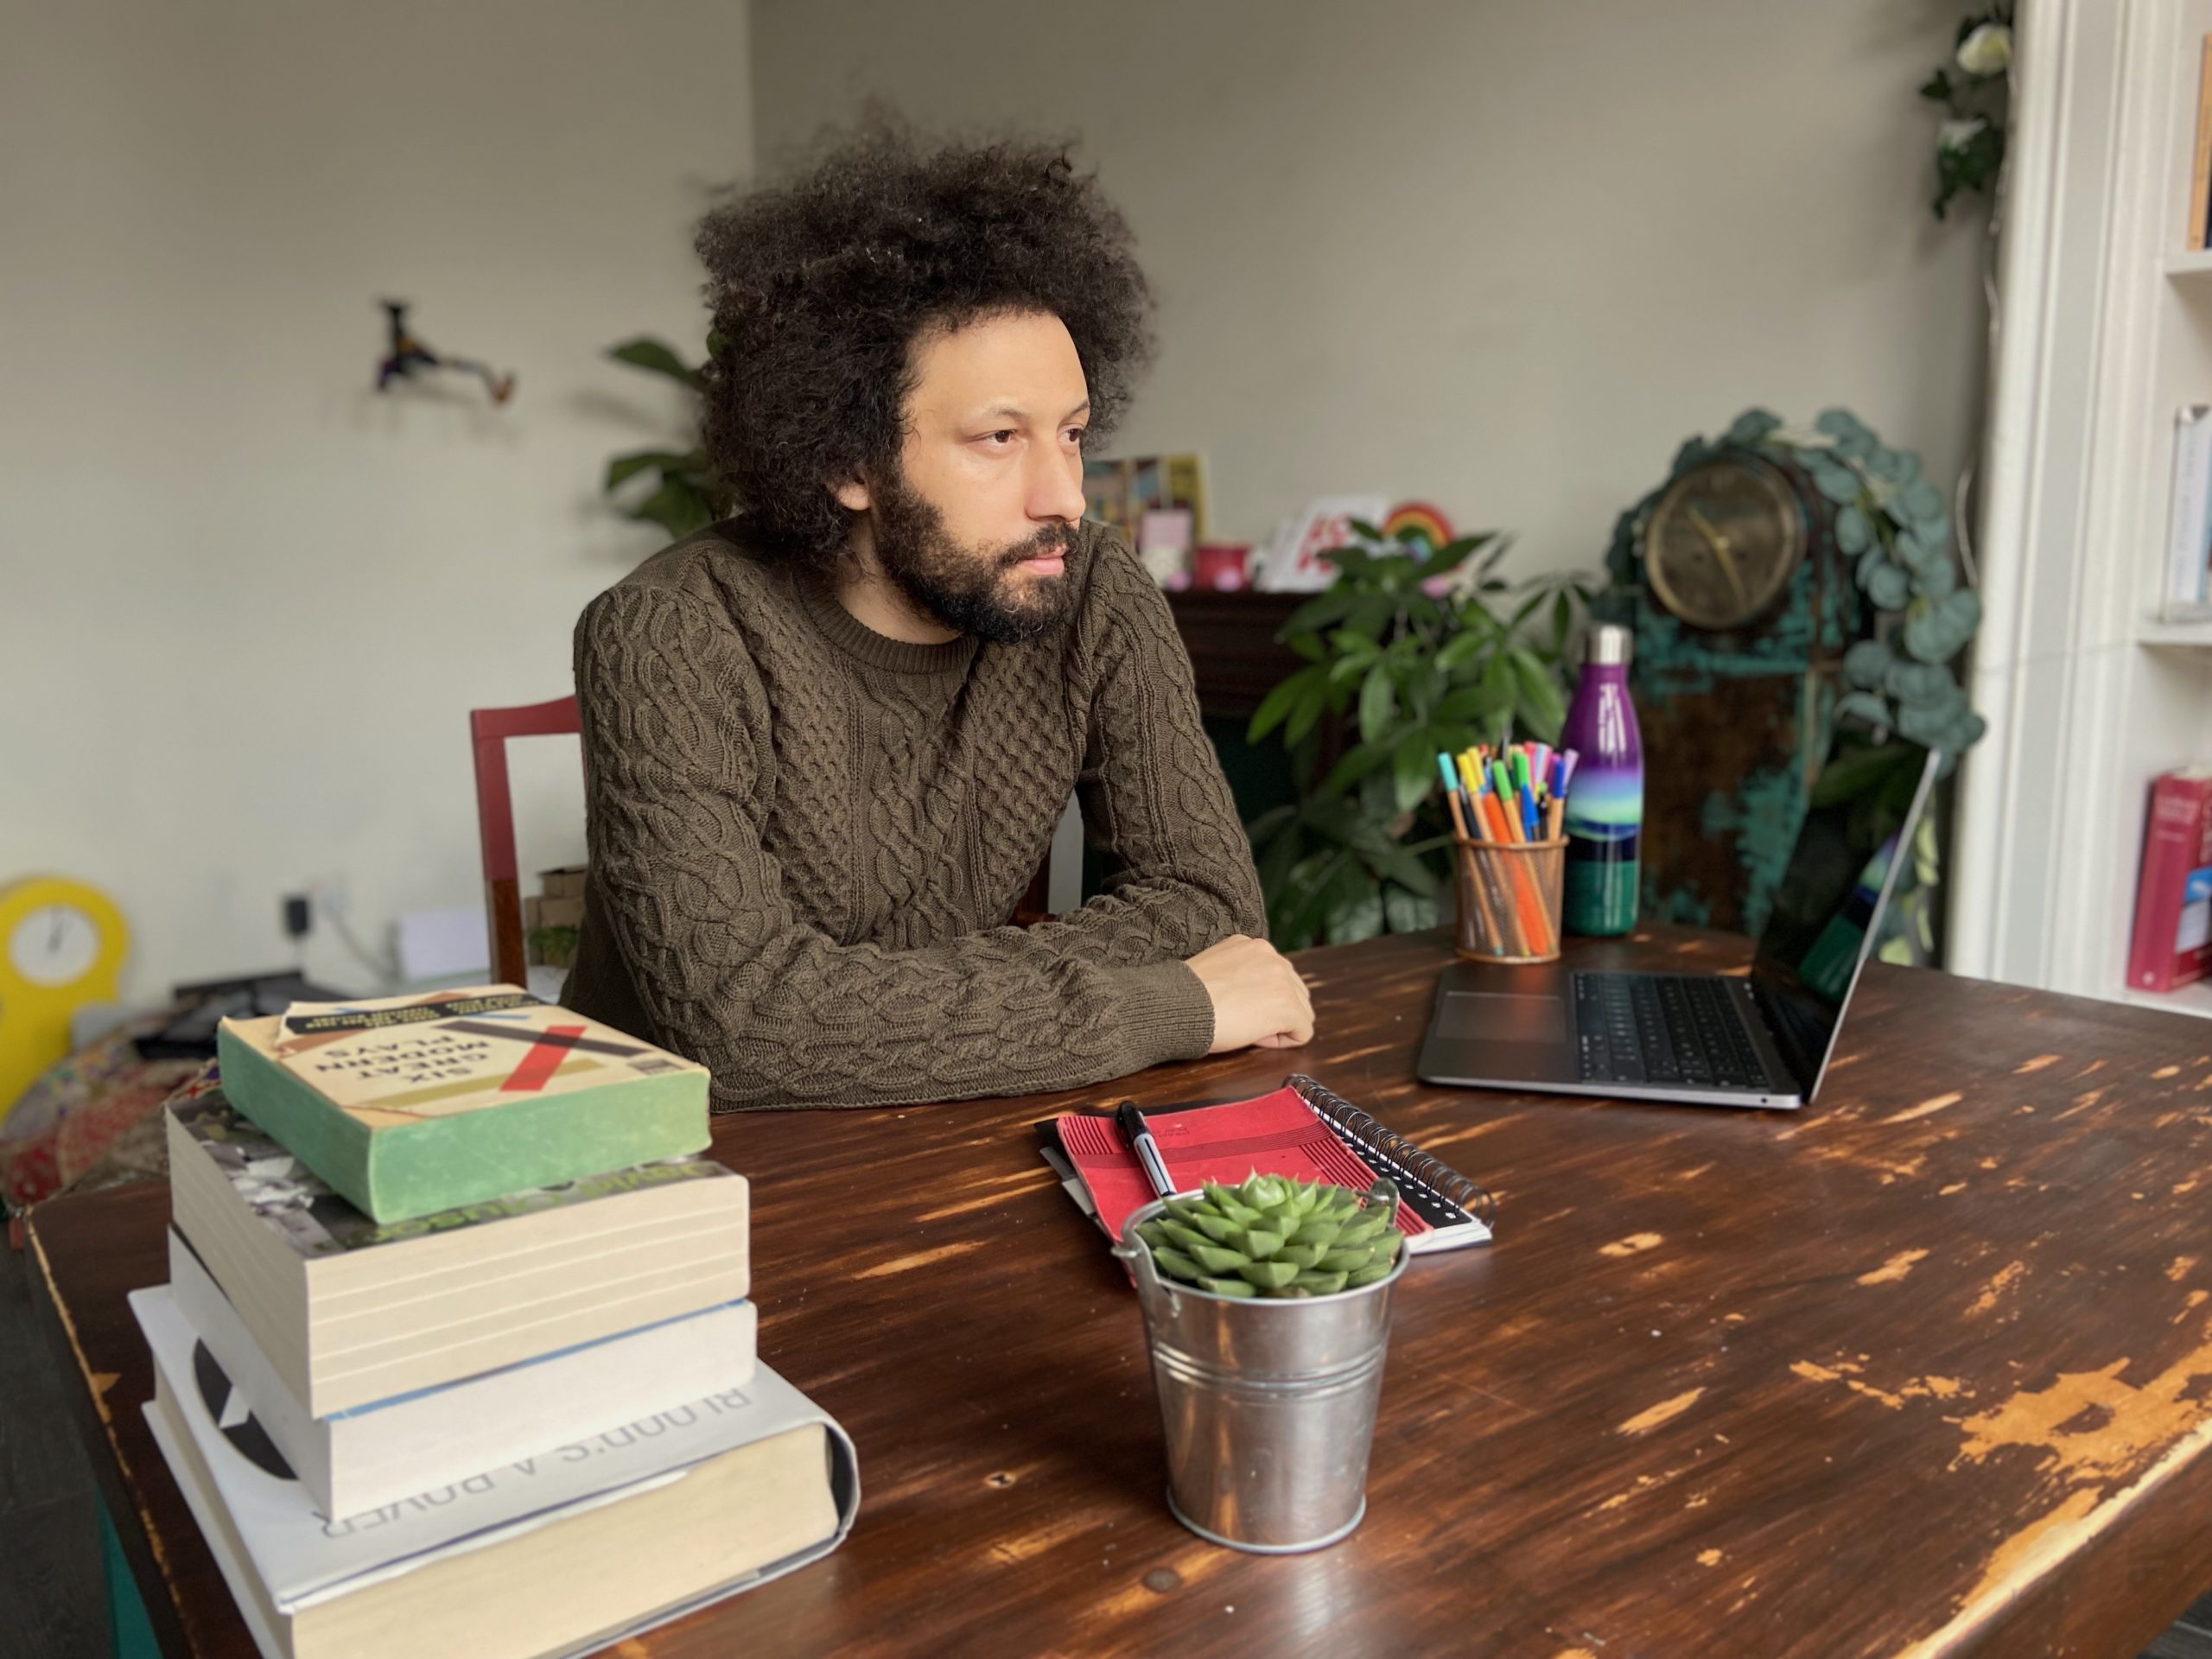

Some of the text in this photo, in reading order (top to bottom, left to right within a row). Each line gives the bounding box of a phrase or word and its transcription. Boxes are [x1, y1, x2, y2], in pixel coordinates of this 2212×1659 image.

[315, 1040, 490, 1072] MODERN
[324, 1035, 455, 1058] PLAYS
[356, 1052, 488, 1080] GREAT
[401, 1067, 473, 1083] SIX
